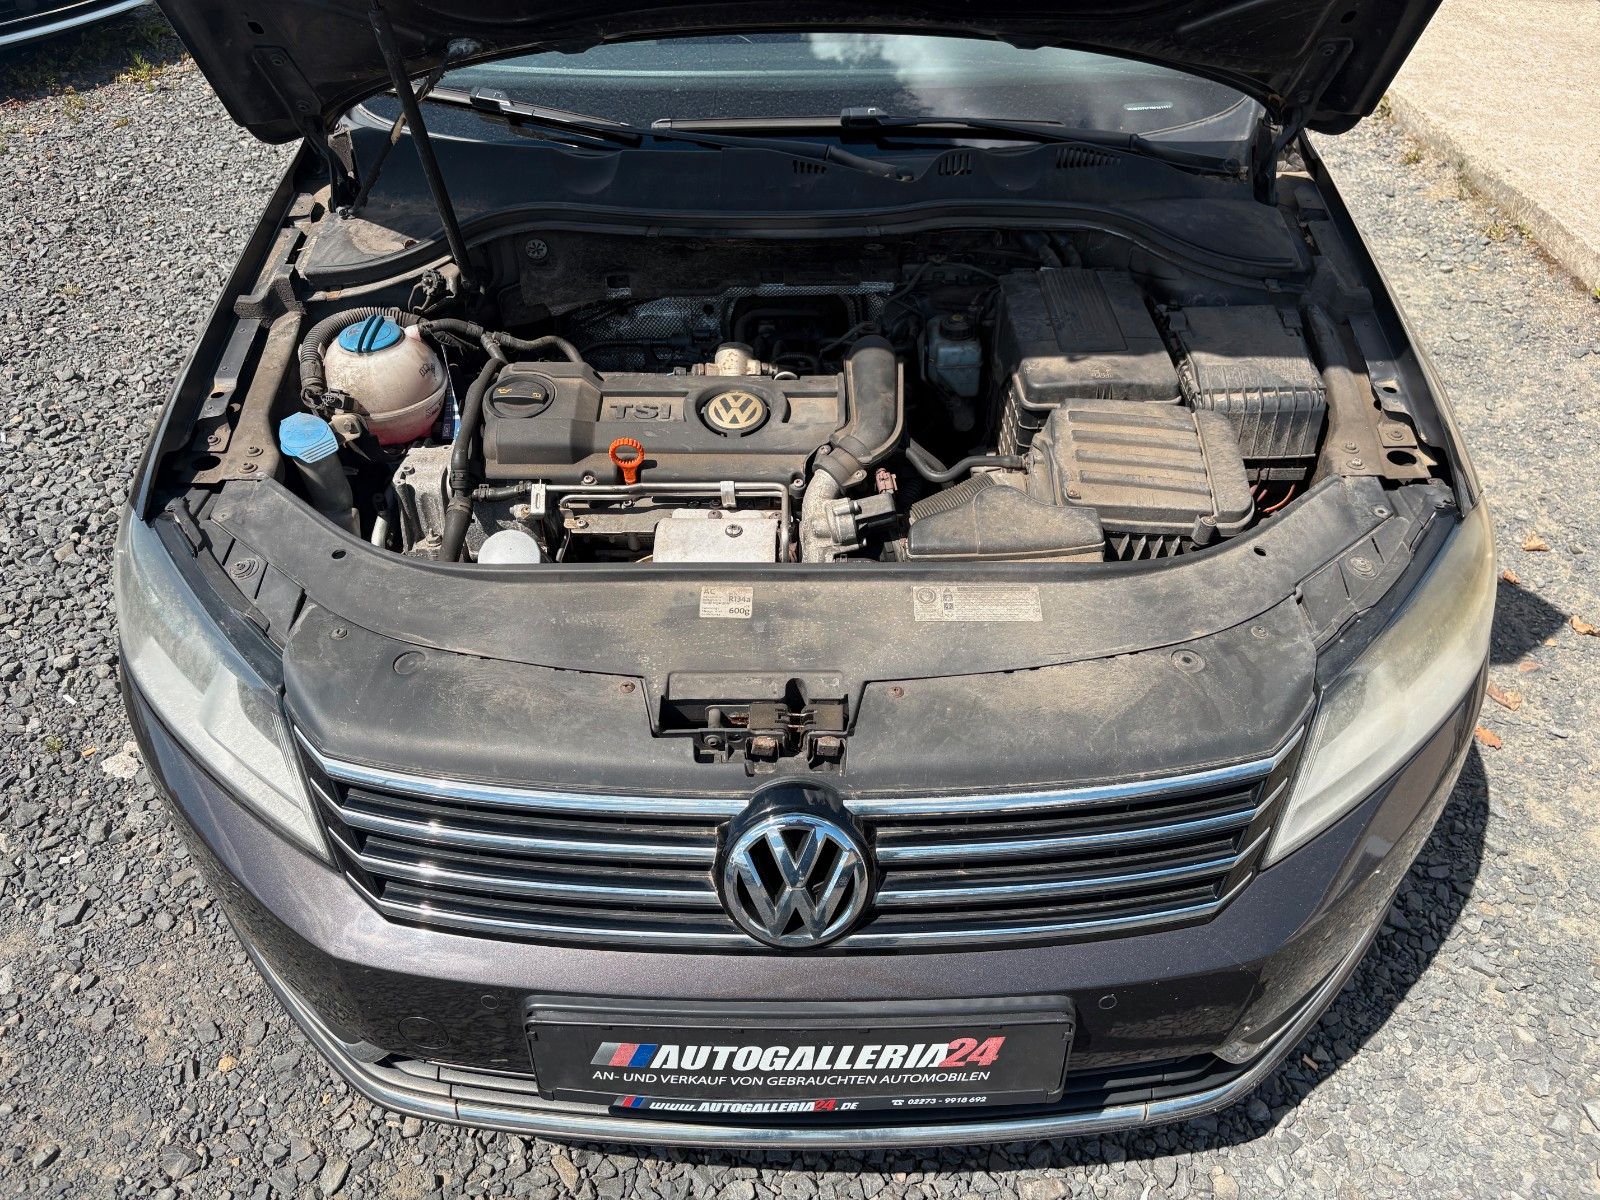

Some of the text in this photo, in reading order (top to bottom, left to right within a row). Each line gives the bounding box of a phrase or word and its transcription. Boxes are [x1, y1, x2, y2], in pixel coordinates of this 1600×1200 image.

[610, 404, 672, 420] TSI
[728, 607, 750, 616] 600g
[650, 1036, 1006, 1072] AUTOGALLERIA24
[592, 1071, 990, 1086] AN- UND VERKAUF VON GEBRAUCHTEN AUTOMOBILEN
[907, 1097, 937, 1106] 02273
[944, 1097, 968, 1105] 9918
[968, 1096, 987, 1105] 692
